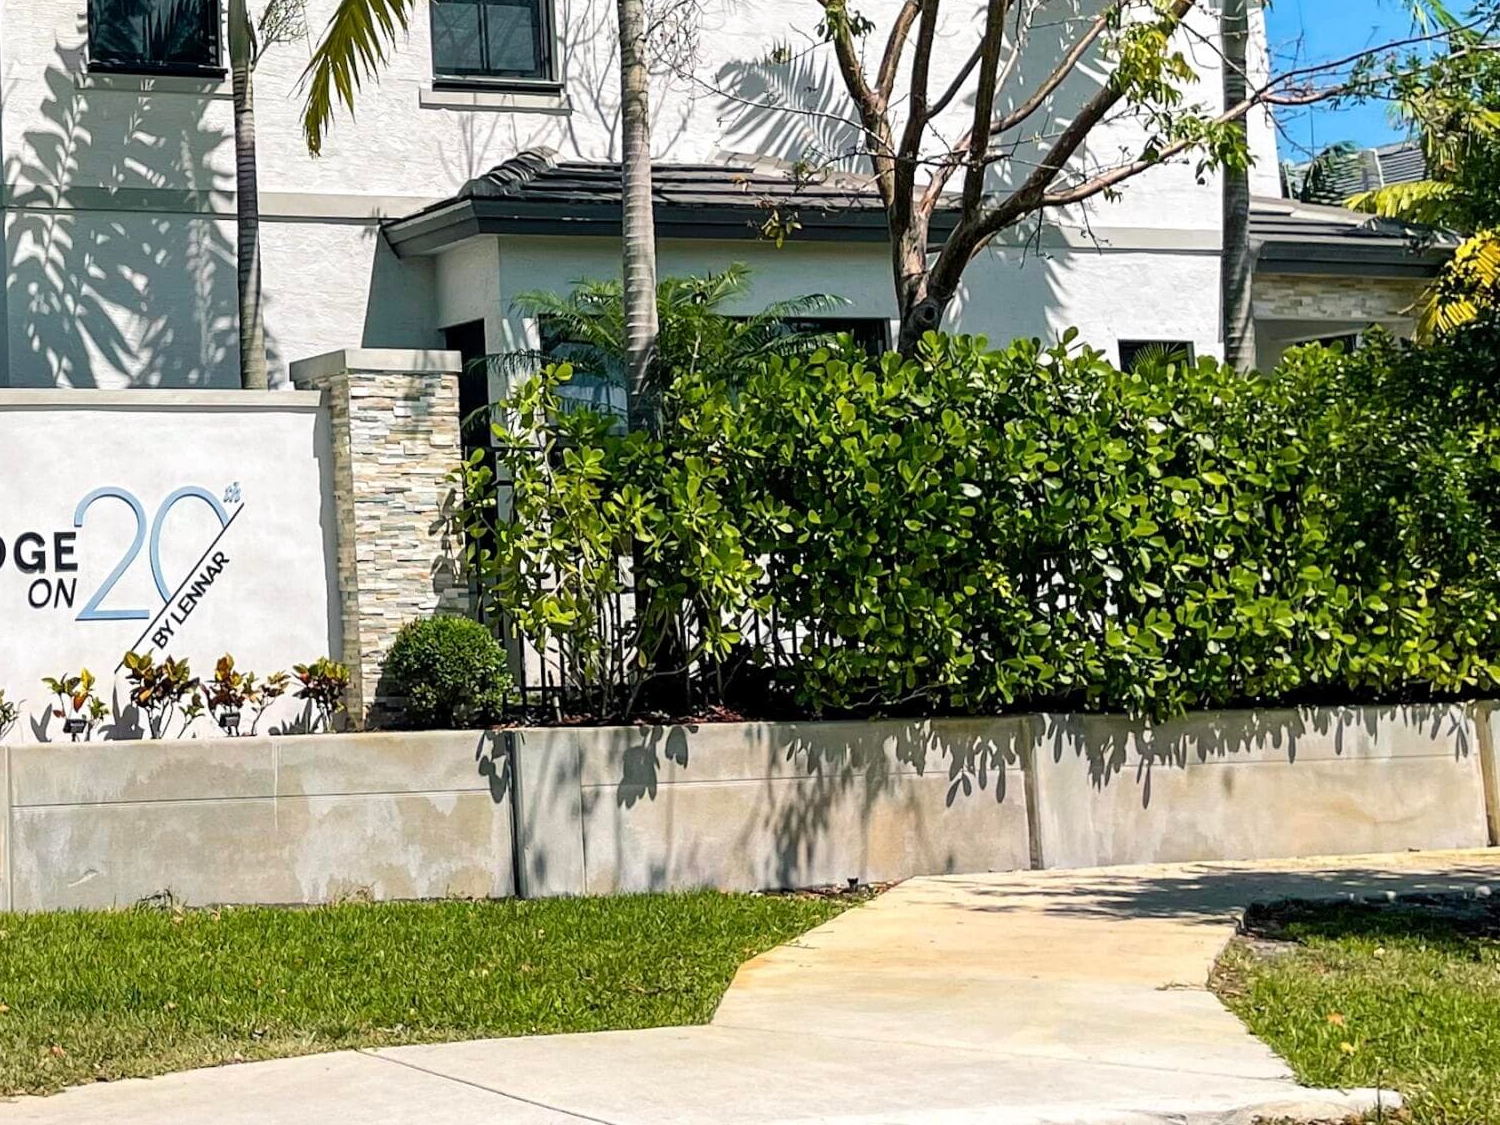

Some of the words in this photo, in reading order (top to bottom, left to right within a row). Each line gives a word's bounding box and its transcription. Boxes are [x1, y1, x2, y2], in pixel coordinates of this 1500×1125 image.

[27, 577, 78, 609] ON
[151, 619, 175, 649] BY
[170, 551, 230, 625] LENNAR
